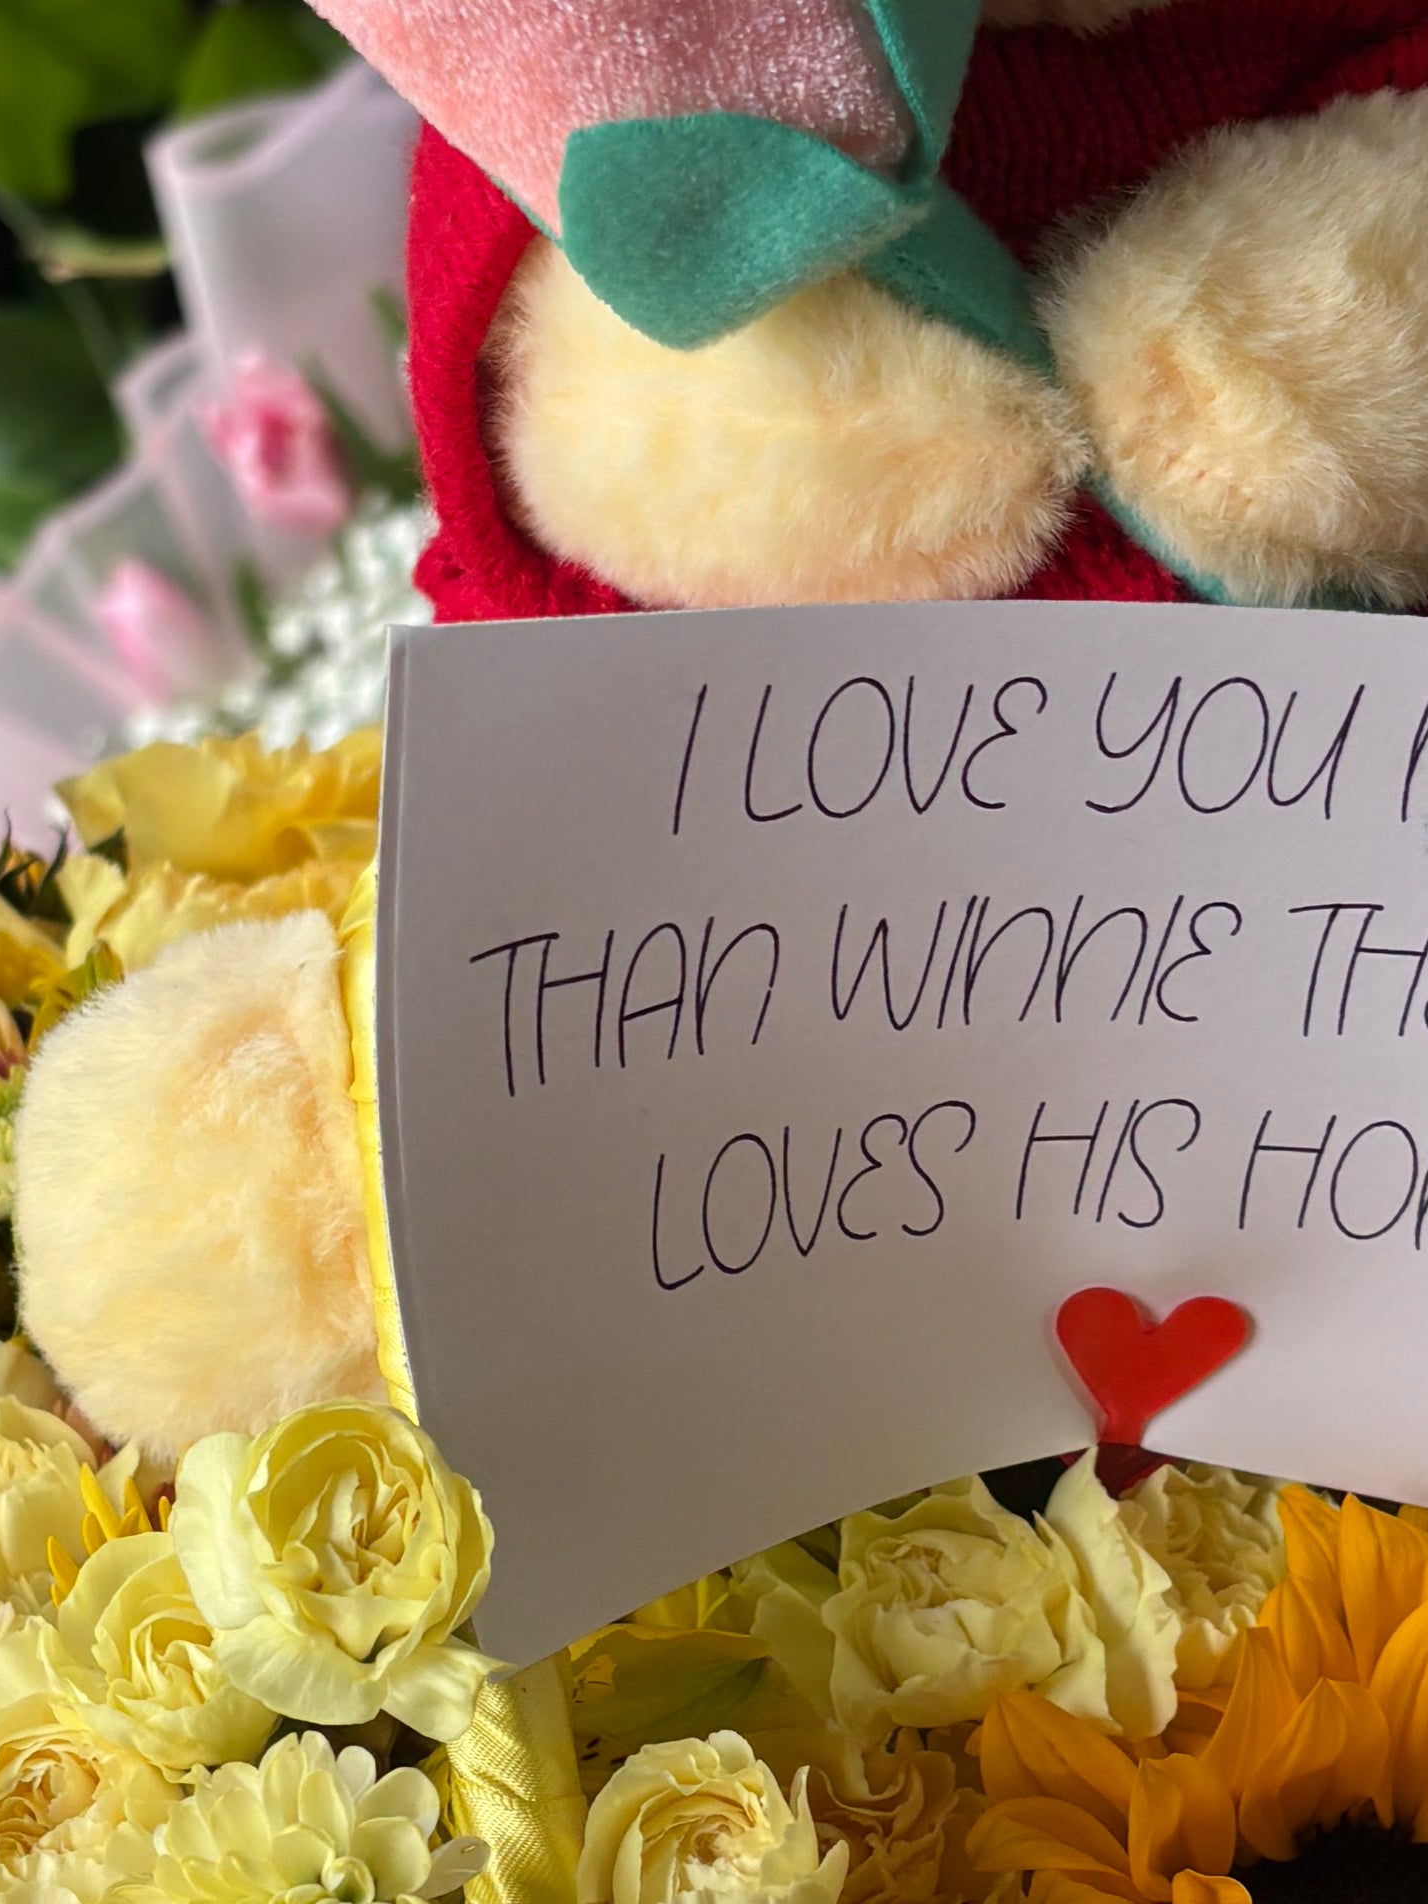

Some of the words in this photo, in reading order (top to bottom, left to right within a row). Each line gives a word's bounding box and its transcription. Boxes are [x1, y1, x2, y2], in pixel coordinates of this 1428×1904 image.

[671, 682, 708, 836] I
[743, 673, 1049, 823] LOVE
[1083, 670, 1366, 821] YOU
[467, 914, 781, 1098] THAN
[829, 893, 1243, 1032] WINNIE
[650, 1098, 977, 1291] LOVES
[1014, 1096, 1202, 1229] HIS
